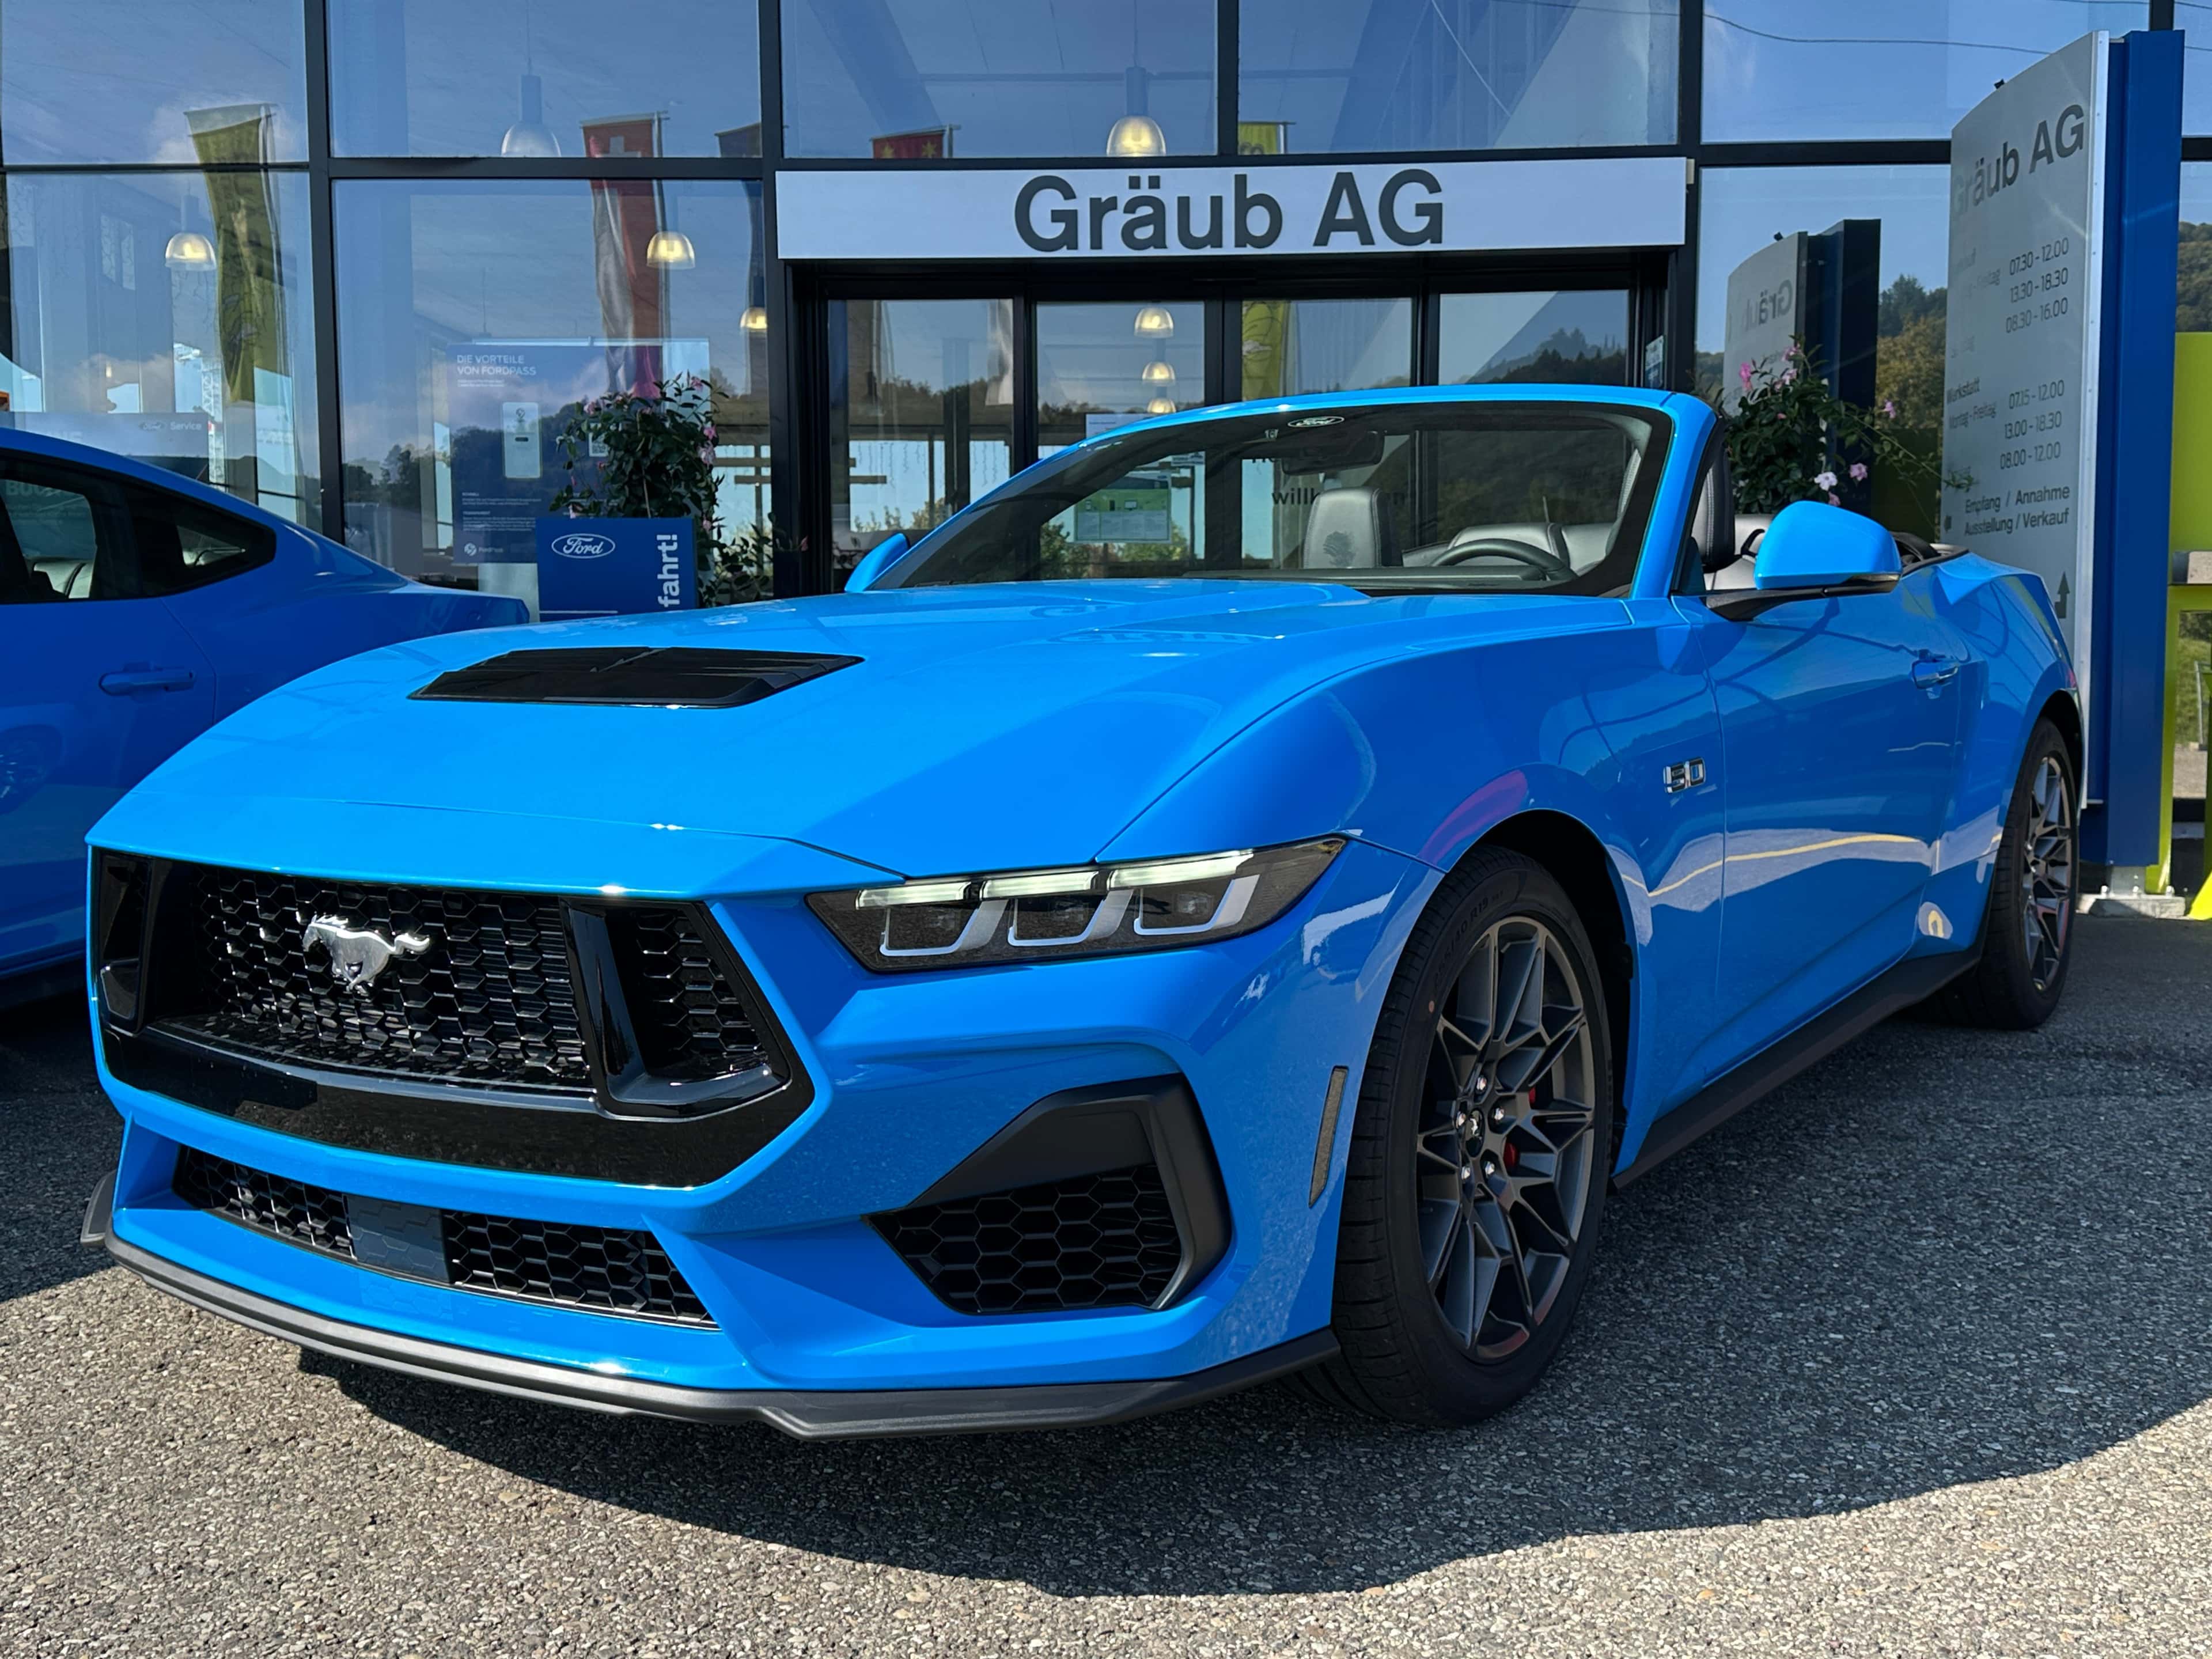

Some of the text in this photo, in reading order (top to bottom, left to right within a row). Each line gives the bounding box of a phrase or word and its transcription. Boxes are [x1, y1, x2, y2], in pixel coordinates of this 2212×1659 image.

[2028, 104, 2084, 175] AG
[1014, 168, 1443, 252] Gräub AG
[2009, 251, 2034, 276] 07.30
[2041, 237, 2069, 263] 12.00
[2010, 280, 2033, 304] 13.30
[2041, 267, 2069, 292] 18.30
[2006, 309, 2032, 334] 08.30
[2040, 297, 2069, 321] 16.00
[457, 354, 525, 365] DIE VORTEILE
[457, 366, 537, 376] VON FORDPASS
[2009, 389, 2030, 410] 07.15
[2038, 379, 2065, 402] 12.00
[170, 421, 202, 431] Service
[2005, 419, 2028, 440] 13.00
[2035, 410, 2062, 433] 18.30
[1999, 448, 2027, 470] 08.00
[2034, 441, 2061, 462] 12.00
[1965, 485, 2070, 516] Empfang / Annahme
[1964, 507, 2070, 536] Ausstellung / Verkauf
[562, 536, 604, 555] Ford
[656, 533, 681, 608] fahrt!
